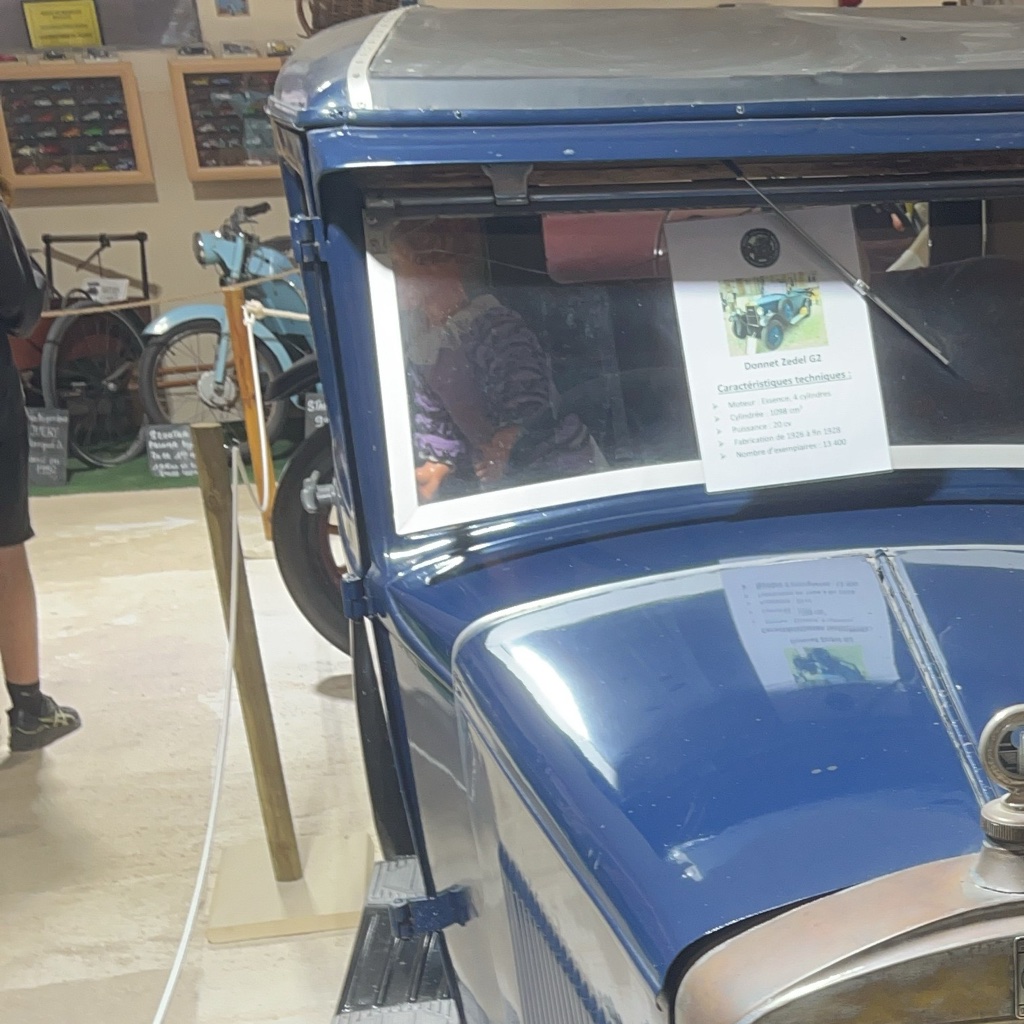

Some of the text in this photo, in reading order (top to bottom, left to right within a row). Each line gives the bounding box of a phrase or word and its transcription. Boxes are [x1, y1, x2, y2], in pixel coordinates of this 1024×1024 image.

[744, 354, 822, 371] Donnet Zedel G2
[717, 377, 793, 393] Caractéristiques
[795, 371, 846, 384] techniques
